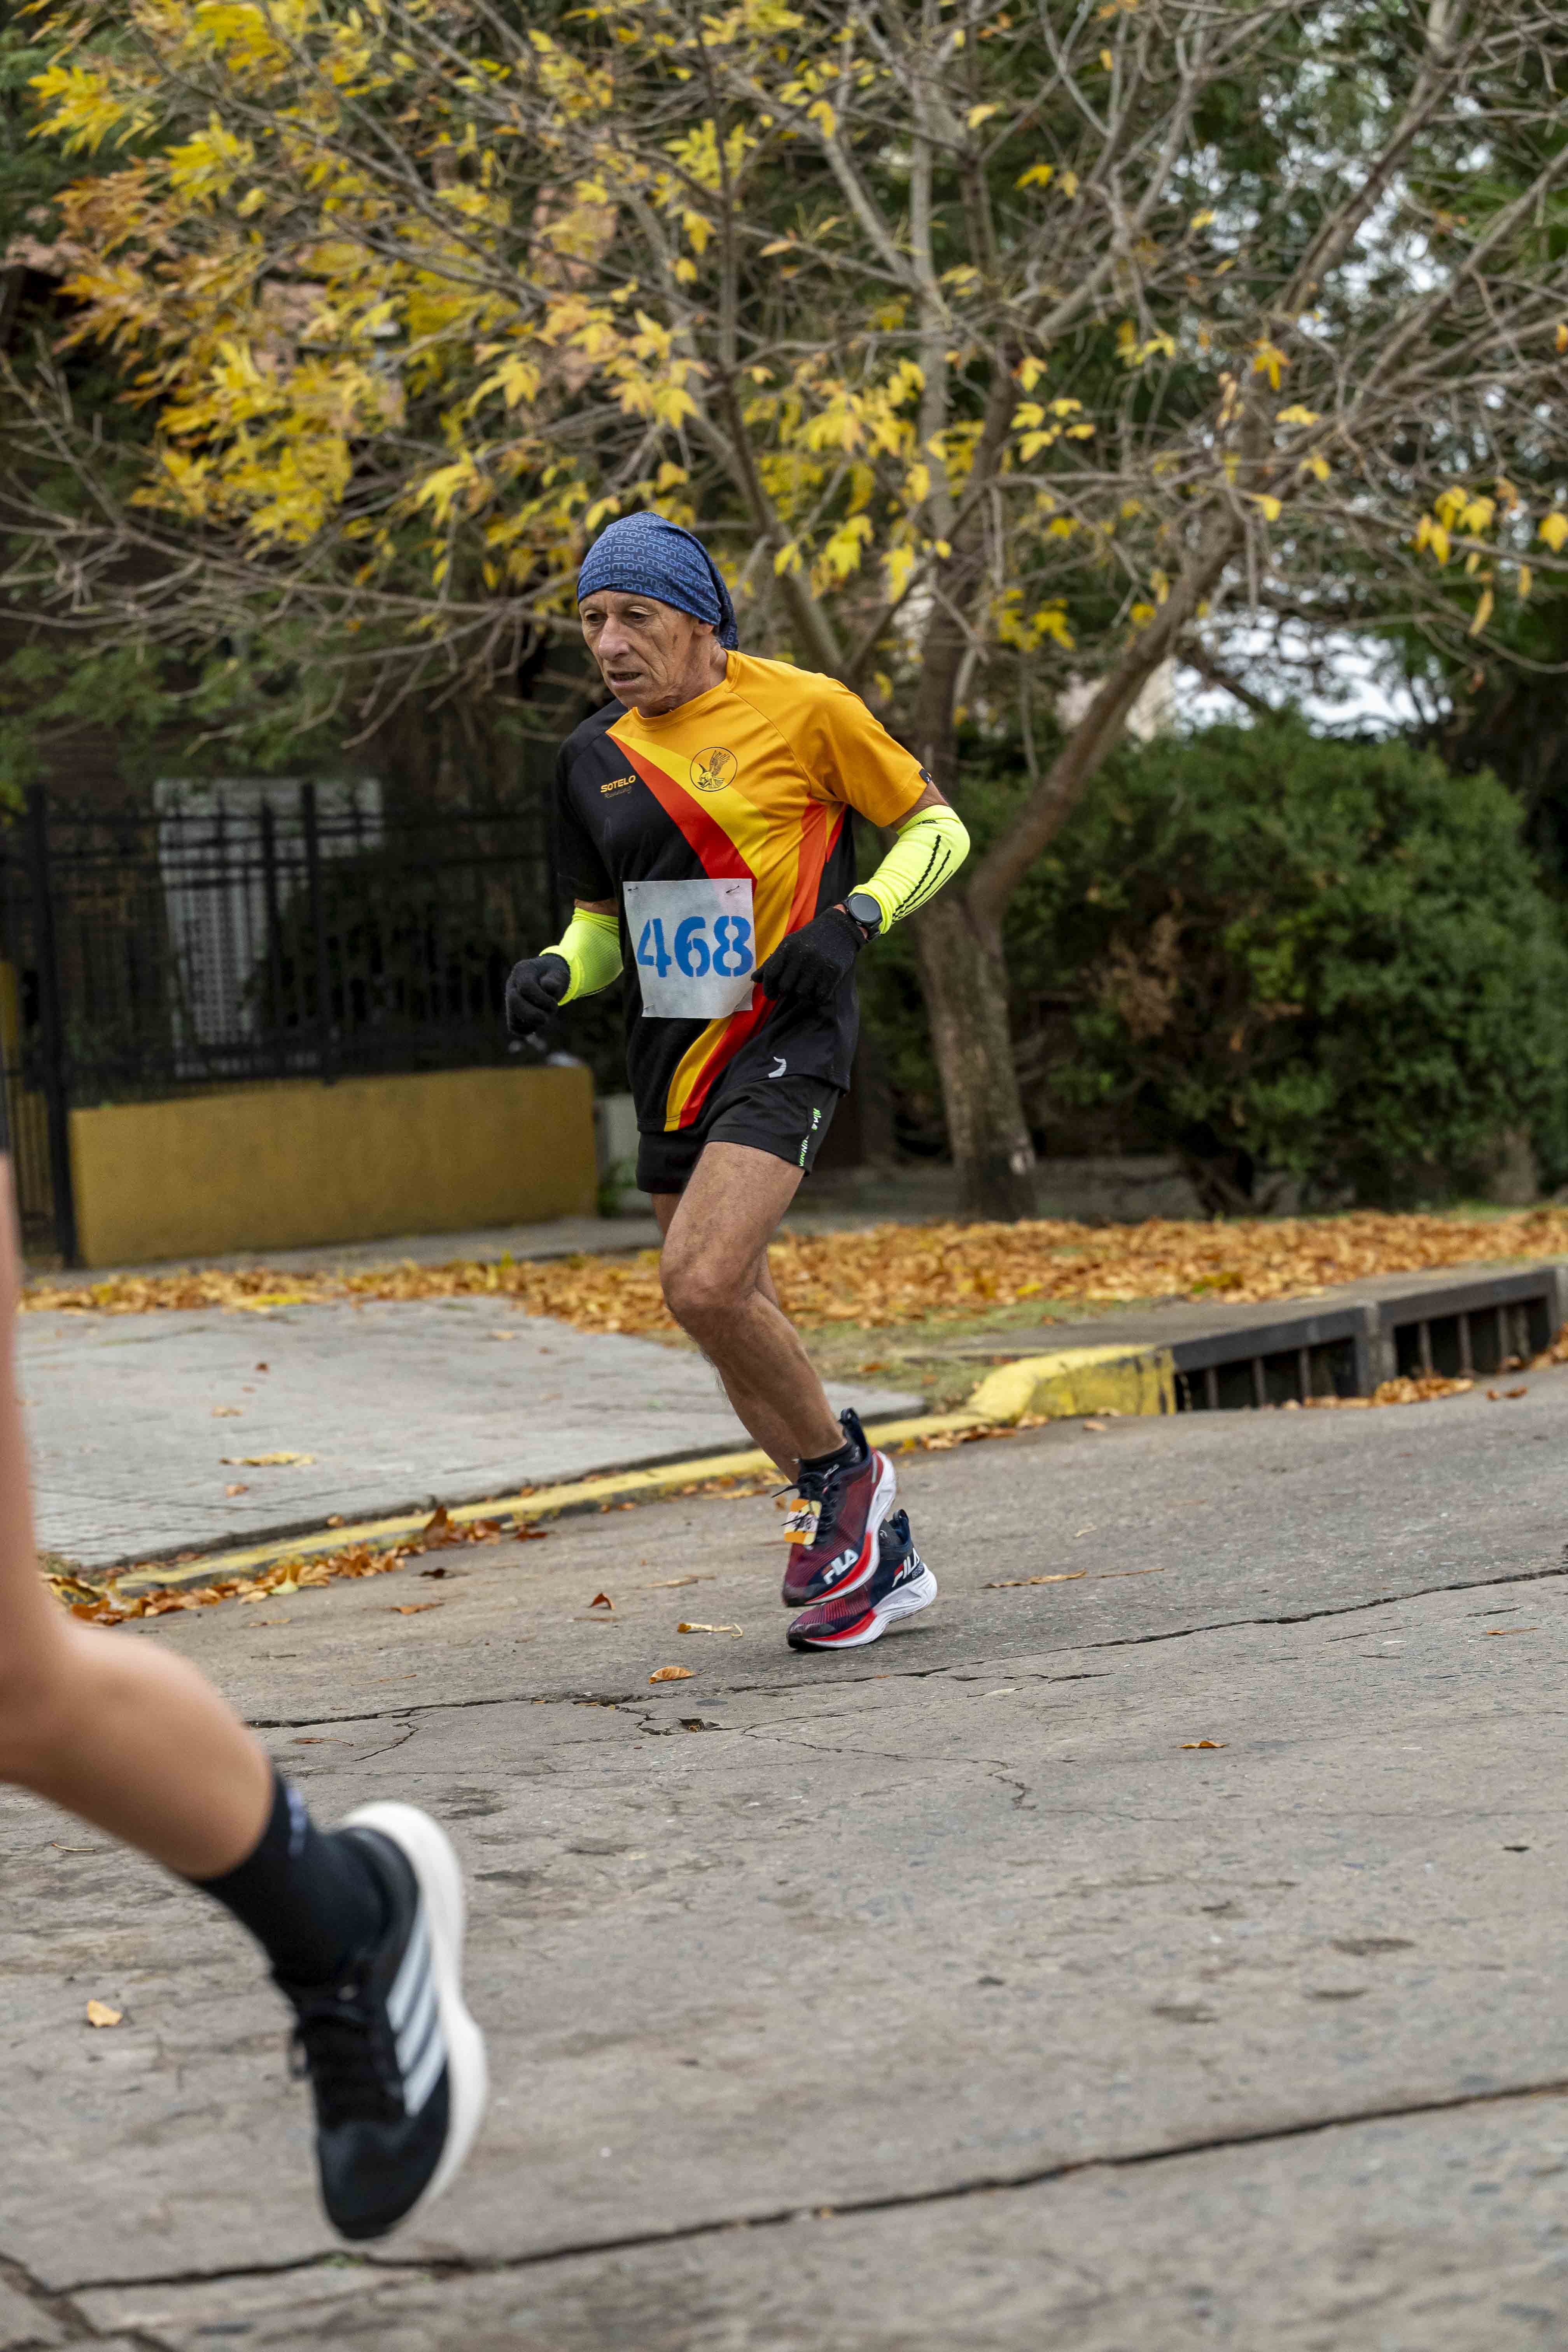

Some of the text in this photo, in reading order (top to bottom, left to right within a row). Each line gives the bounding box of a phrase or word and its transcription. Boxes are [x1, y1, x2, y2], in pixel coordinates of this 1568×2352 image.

[614, 537, 676, 558] salomon
[613, 553, 676, 576] salomon
[612, 572, 672, 594] salomon
[600, 775, 636, 793] SOTELO
[637, 915, 754, 978] 468
[821, 1549, 859, 1585] FILA
[891, 1547, 920, 1588] FILA
